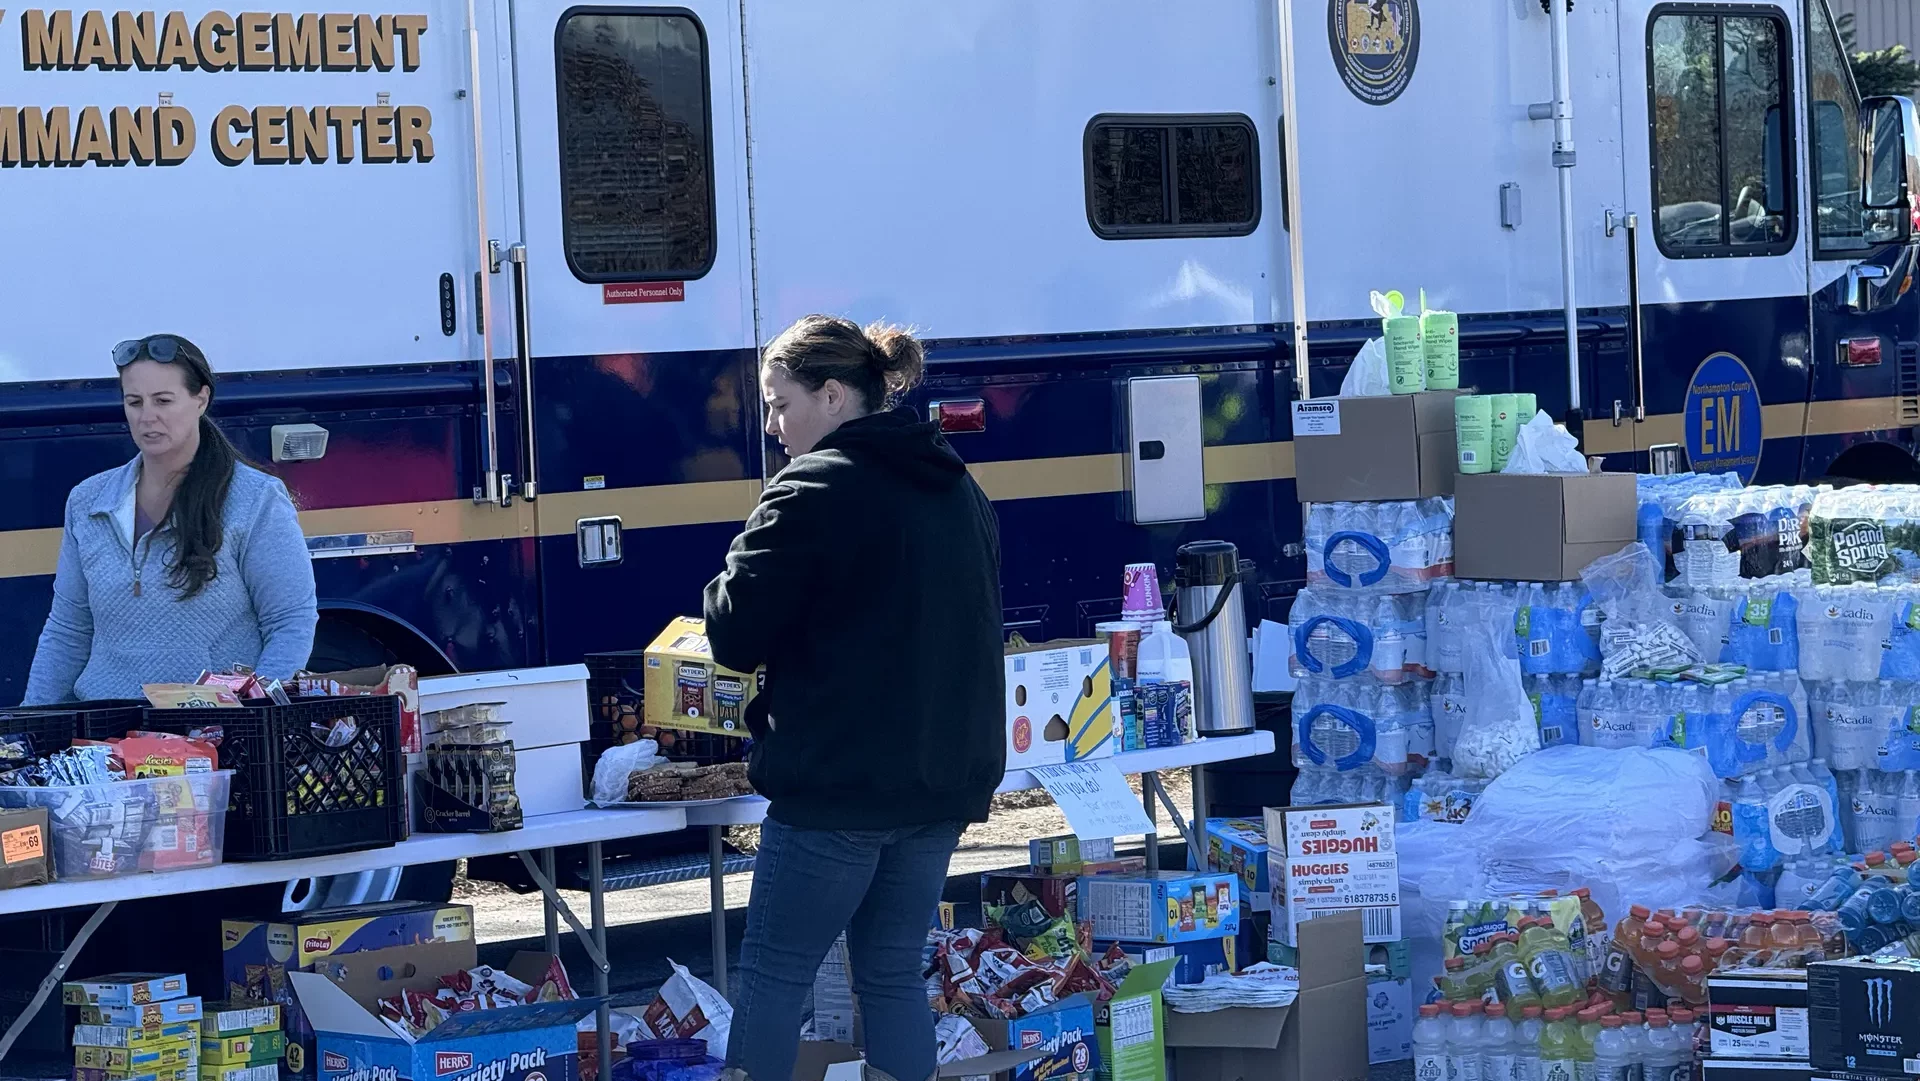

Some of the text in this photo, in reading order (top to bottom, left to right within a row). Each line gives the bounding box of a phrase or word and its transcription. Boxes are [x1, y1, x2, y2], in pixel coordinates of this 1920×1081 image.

[21, 9, 427, 73] MANAGEMENT
[211, 104, 434, 167] CENTER
[606, 286, 683, 298] Authorized Personnel Only
[1692, 381, 1751, 396] Northampton County
[1297, 403, 1333, 413] Aramsco
[1701, 395, 1740, 454] EM
[1832, 524, 1885, 552] Poland
[1836, 543, 1889, 567] Spring
[1750, 603, 1768, 616] 35
[1836, 713, 1873, 725] Acadia
[1302, 836, 1379, 855] HUGGIES
[1246, 869, 1255, 881] 10
[1291, 863, 1349, 877] HUGGIES
[1298, 878, 1322, 886] simply
[1344, 893, 1389, 904] 618378735
[1607, 952, 1624, 972] G
[1508, 962, 1527, 979] G
[1727, 1014, 1770, 1027] MUSCLE MILK
[1061, 1027, 1082, 1048] Pack
[1732, 1039, 1740, 1047] 25
[1859, 1033, 1903, 1044] MONSTER
[289, 1047, 300, 1063] 42
[510, 1048, 546, 1074] Pack
[1075, 1048, 1086, 1062] 28
[1845, 1056, 1856, 1066] 12
[439, 1055, 469, 1070] HERR'S
[1418, 1068, 1442, 1077] ZERO
[1831, 1073, 1863, 1081] ESSENTIAL
